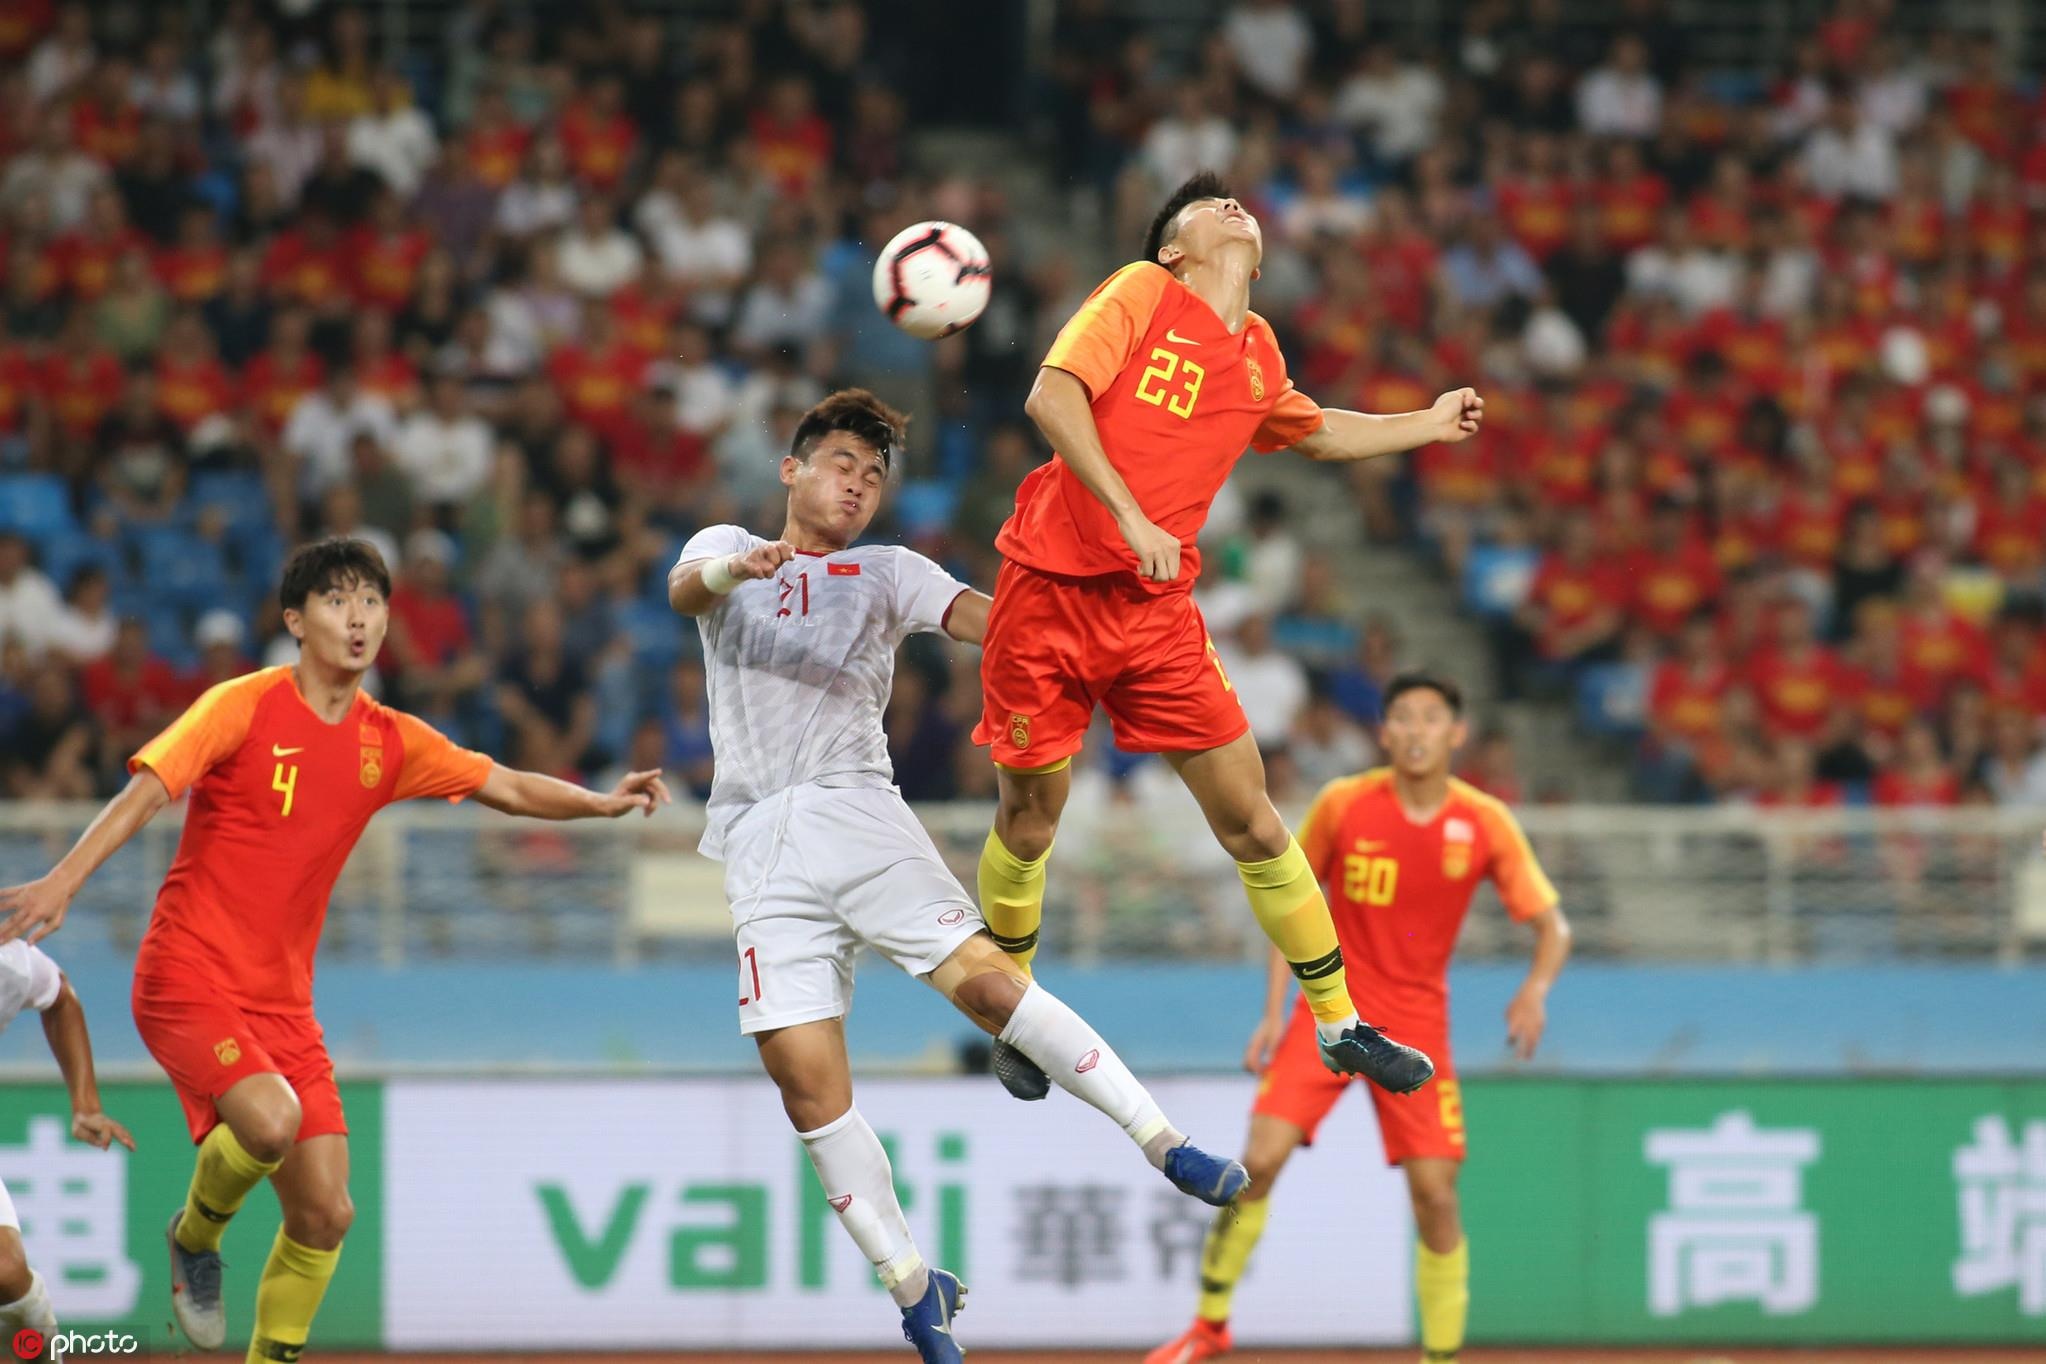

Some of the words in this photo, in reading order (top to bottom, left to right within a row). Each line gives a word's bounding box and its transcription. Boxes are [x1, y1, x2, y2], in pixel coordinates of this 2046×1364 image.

[1135, 347, 1205, 419] 23
[271, 762, 298, 816] 4
[1344, 854, 1398, 907] 20
[738, 947, 761, 1006] 1
